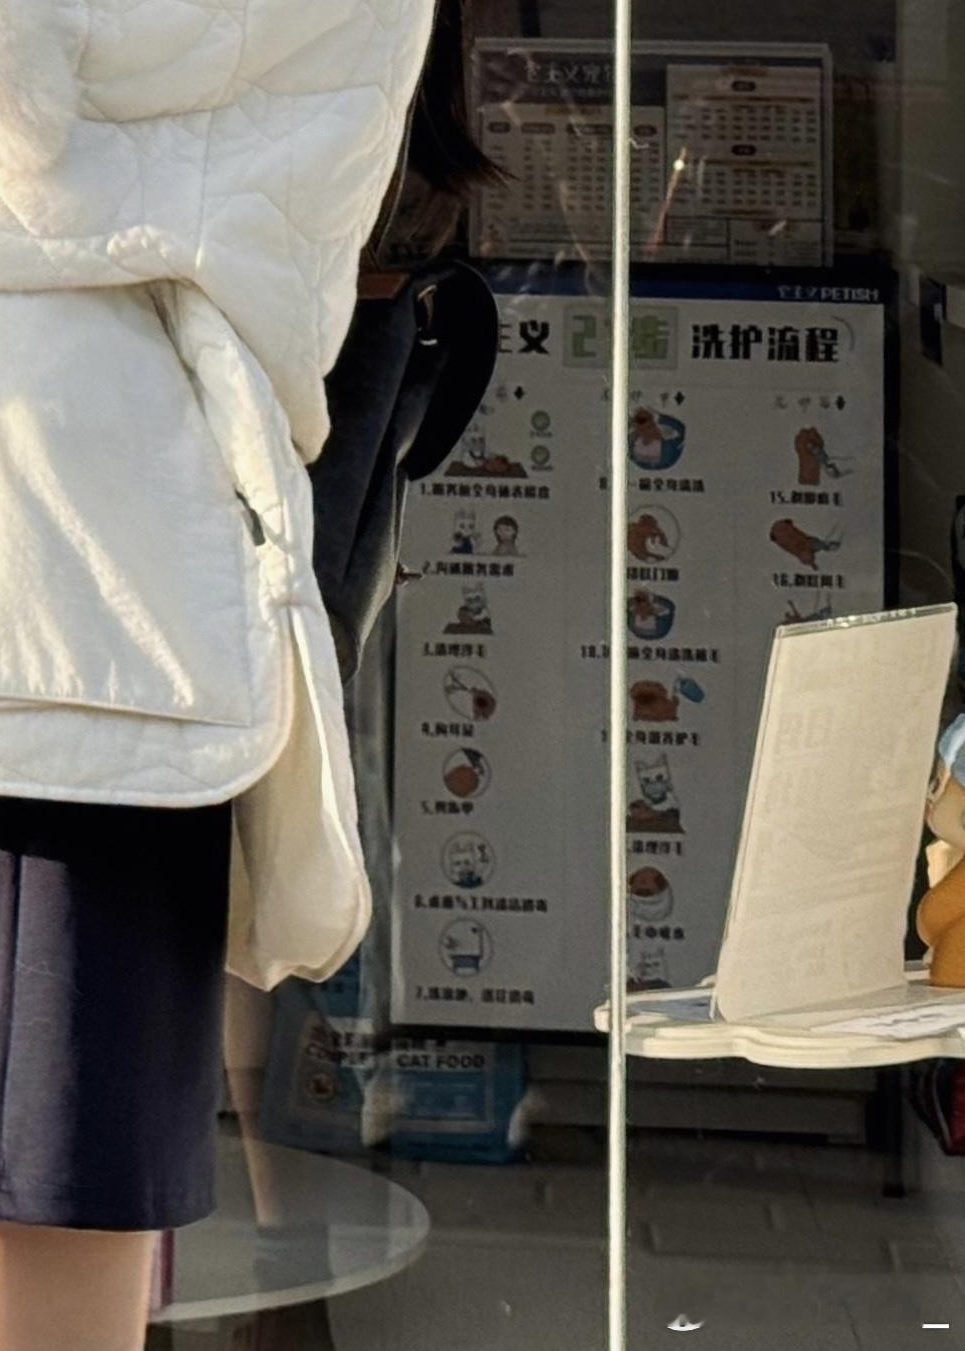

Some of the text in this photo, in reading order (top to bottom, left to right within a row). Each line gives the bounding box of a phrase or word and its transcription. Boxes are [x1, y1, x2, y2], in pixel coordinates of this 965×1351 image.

[691, 324, 839, 363] 洗护流程
[397, 1054, 429, 1068] CAT
[436, 1055, 486, 1069] FOOD
